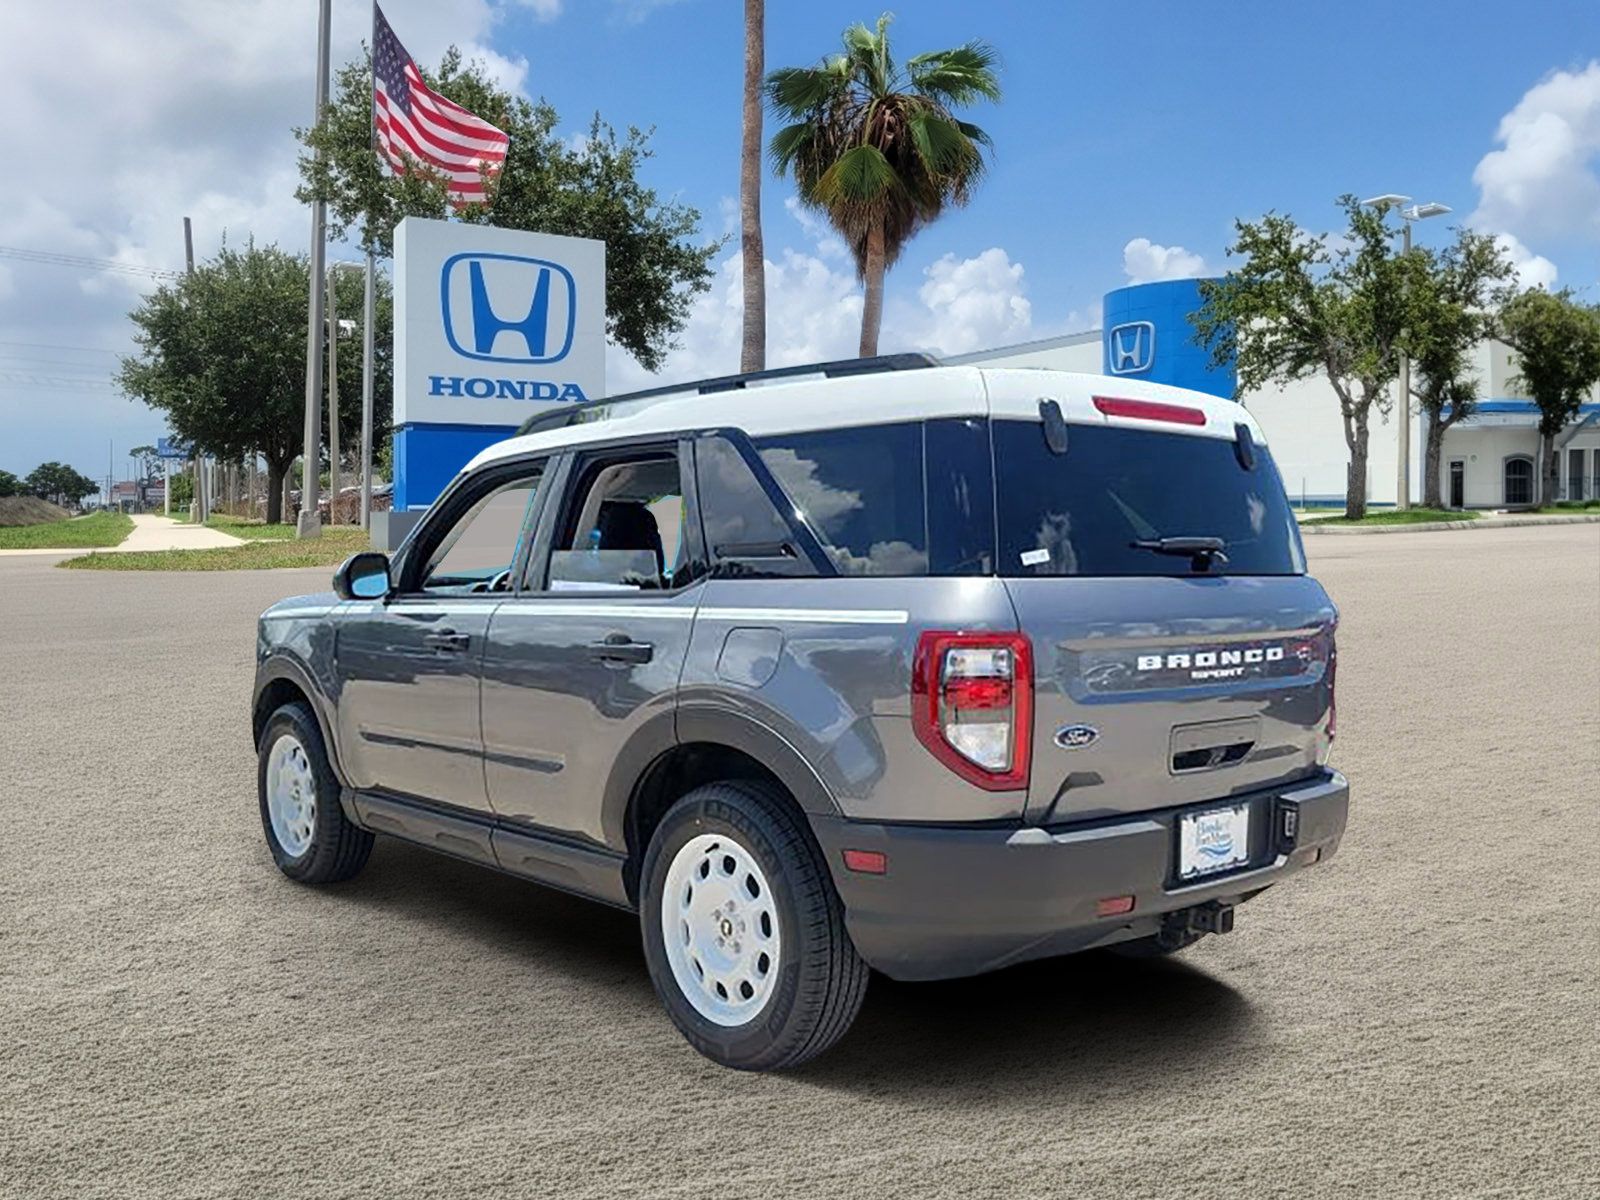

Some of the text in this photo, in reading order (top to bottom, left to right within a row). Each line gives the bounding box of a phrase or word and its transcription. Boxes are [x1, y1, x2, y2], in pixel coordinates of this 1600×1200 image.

[428, 375, 589, 402] HONDA
[1137, 647, 1284, 671] BRONCO
[1191, 667, 1244, 679] SPORT
